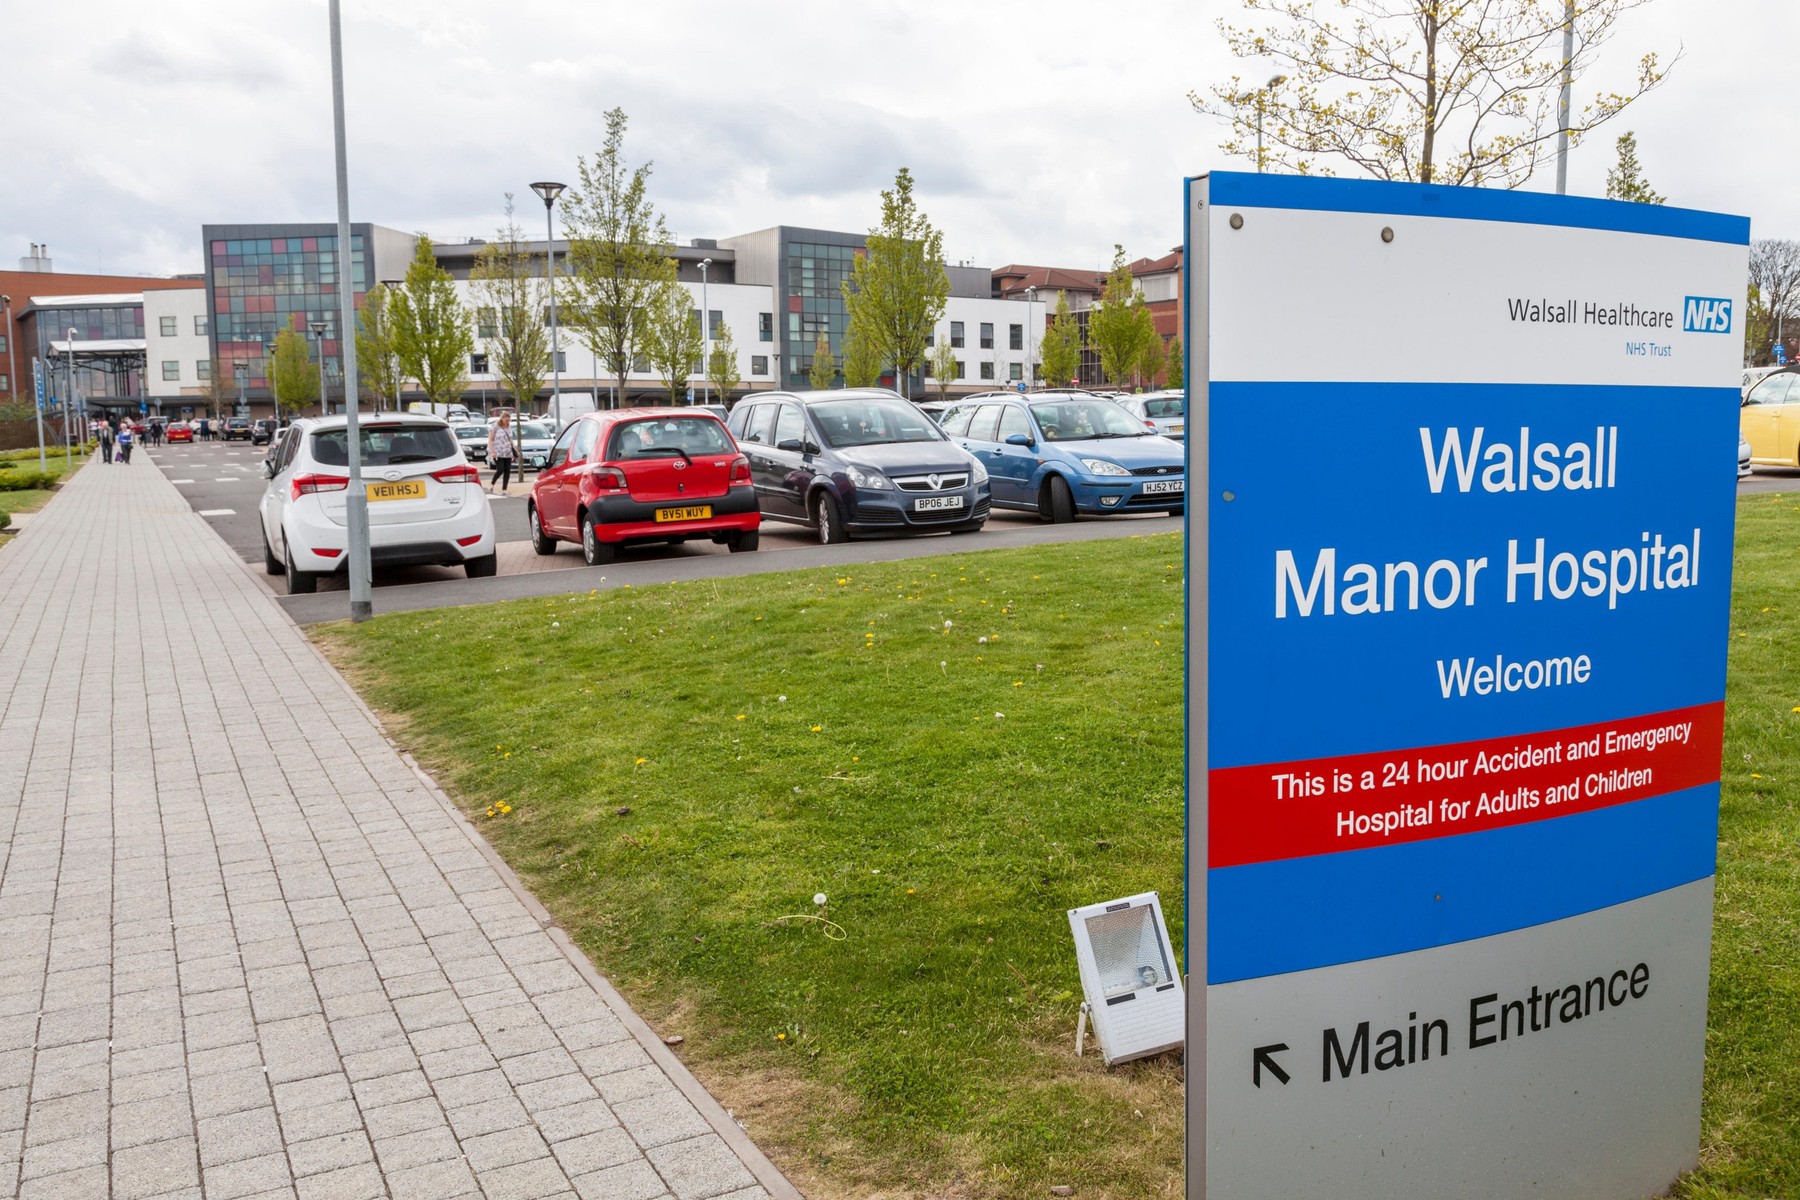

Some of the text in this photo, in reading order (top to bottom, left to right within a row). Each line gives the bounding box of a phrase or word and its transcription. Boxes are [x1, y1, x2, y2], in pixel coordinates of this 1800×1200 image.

[1507, 298, 1731, 333] Walsall Healthcare NHS
[1626, 341, 1672, 358] NHS Trust
[1419, 426, 1618, 494] Walsall
[373, 484, 419, 497] VE11 HSJ
[919, 497, 960, 509] BP06 JEJ
[1146, 481, 1183, 492] HJ52 YCZ
[662, 507, 705, 520] BV51 WUY
[1275, 527, 1701, 619] Manor Hospital
[1436, 654, 1592, 699] Welcome
[1271, 721, 1692, 800] This is a 24 hour Accident and Emergency
[1336, 767, 1653, 837] Hospital for Adults and Children
[1322, 962, 1650, 1083] Main Entrance
